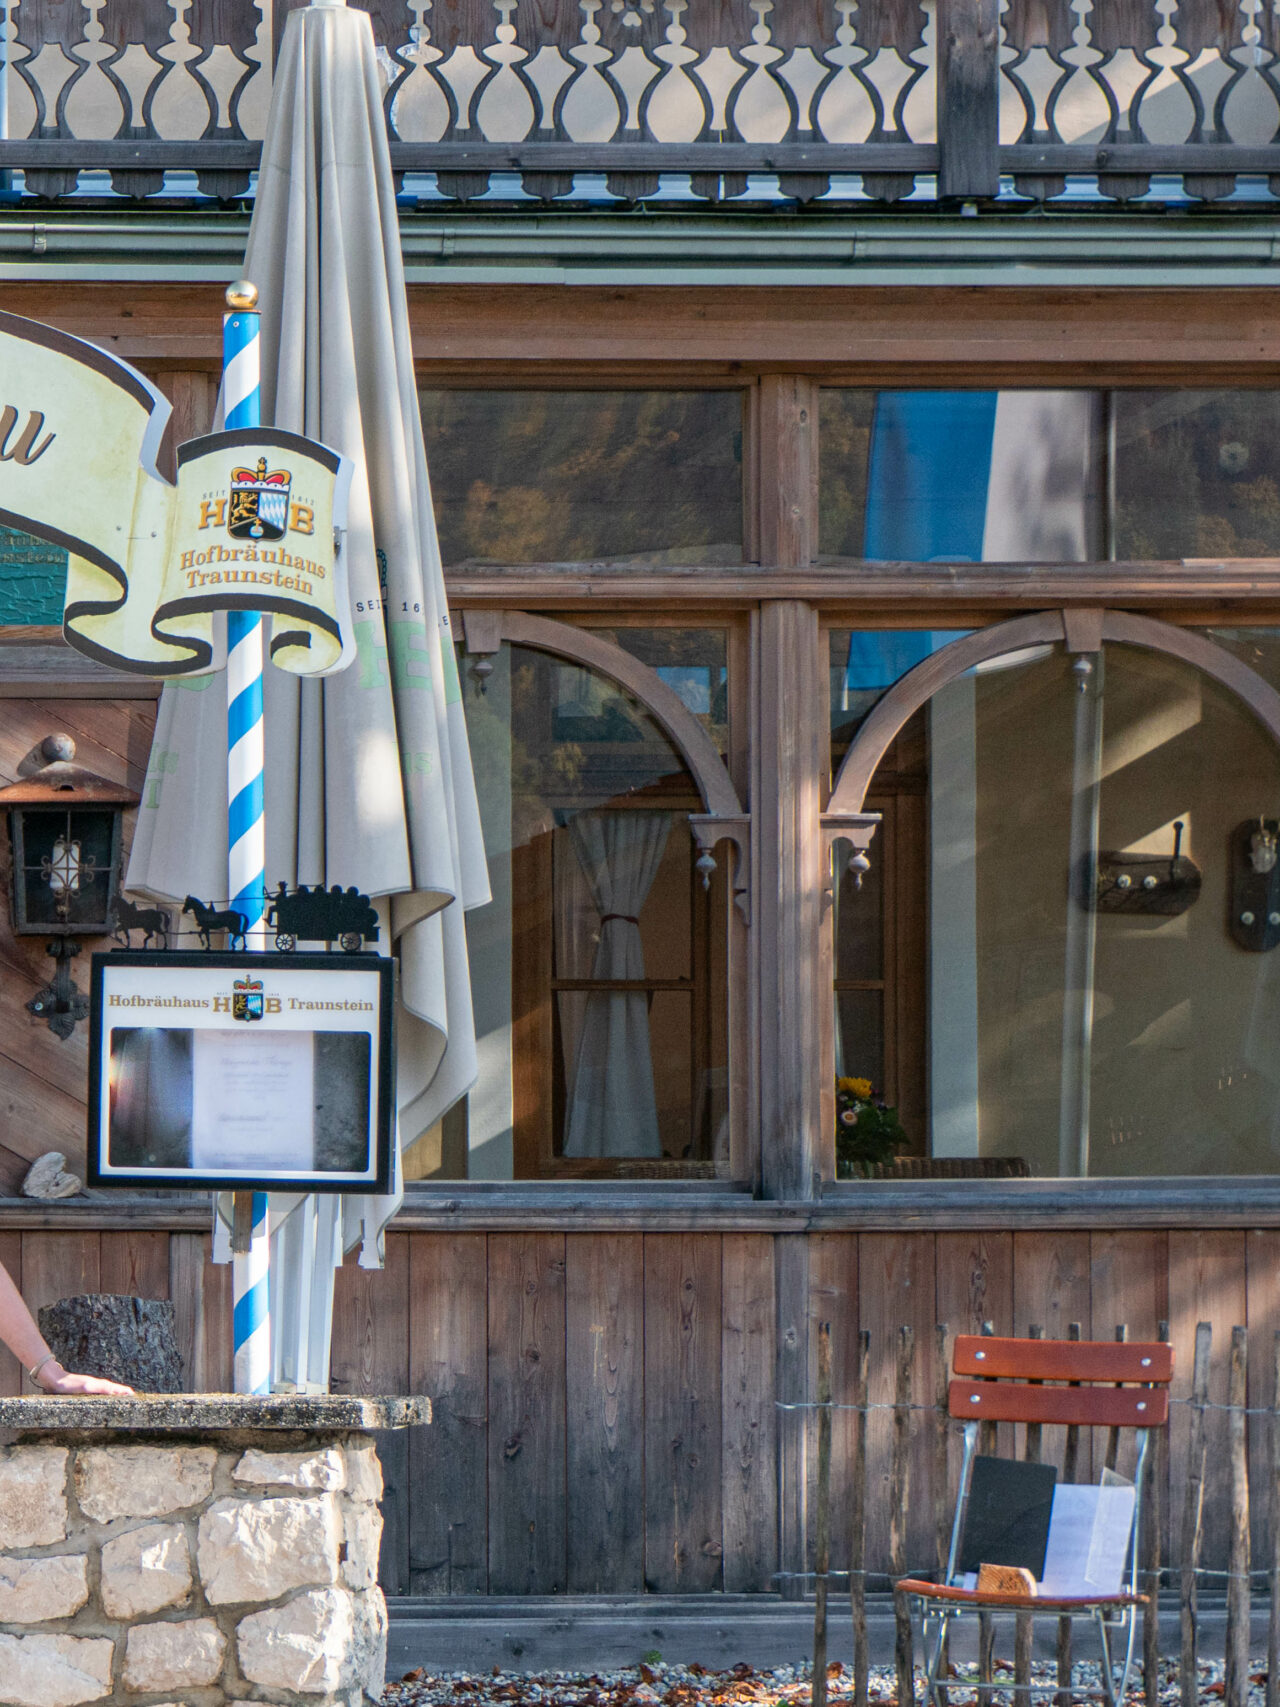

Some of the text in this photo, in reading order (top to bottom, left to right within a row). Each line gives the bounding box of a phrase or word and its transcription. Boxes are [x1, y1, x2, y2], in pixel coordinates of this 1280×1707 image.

[198, 498, 315, 536] H B
[180, 544, 326, 579] Hofbräuhaus
[186, 569, 313, 596] Traunstein
[108, 994, 209, 1009] Hofbräuhaus
[288, 997, 374, 1011] Traunstein
